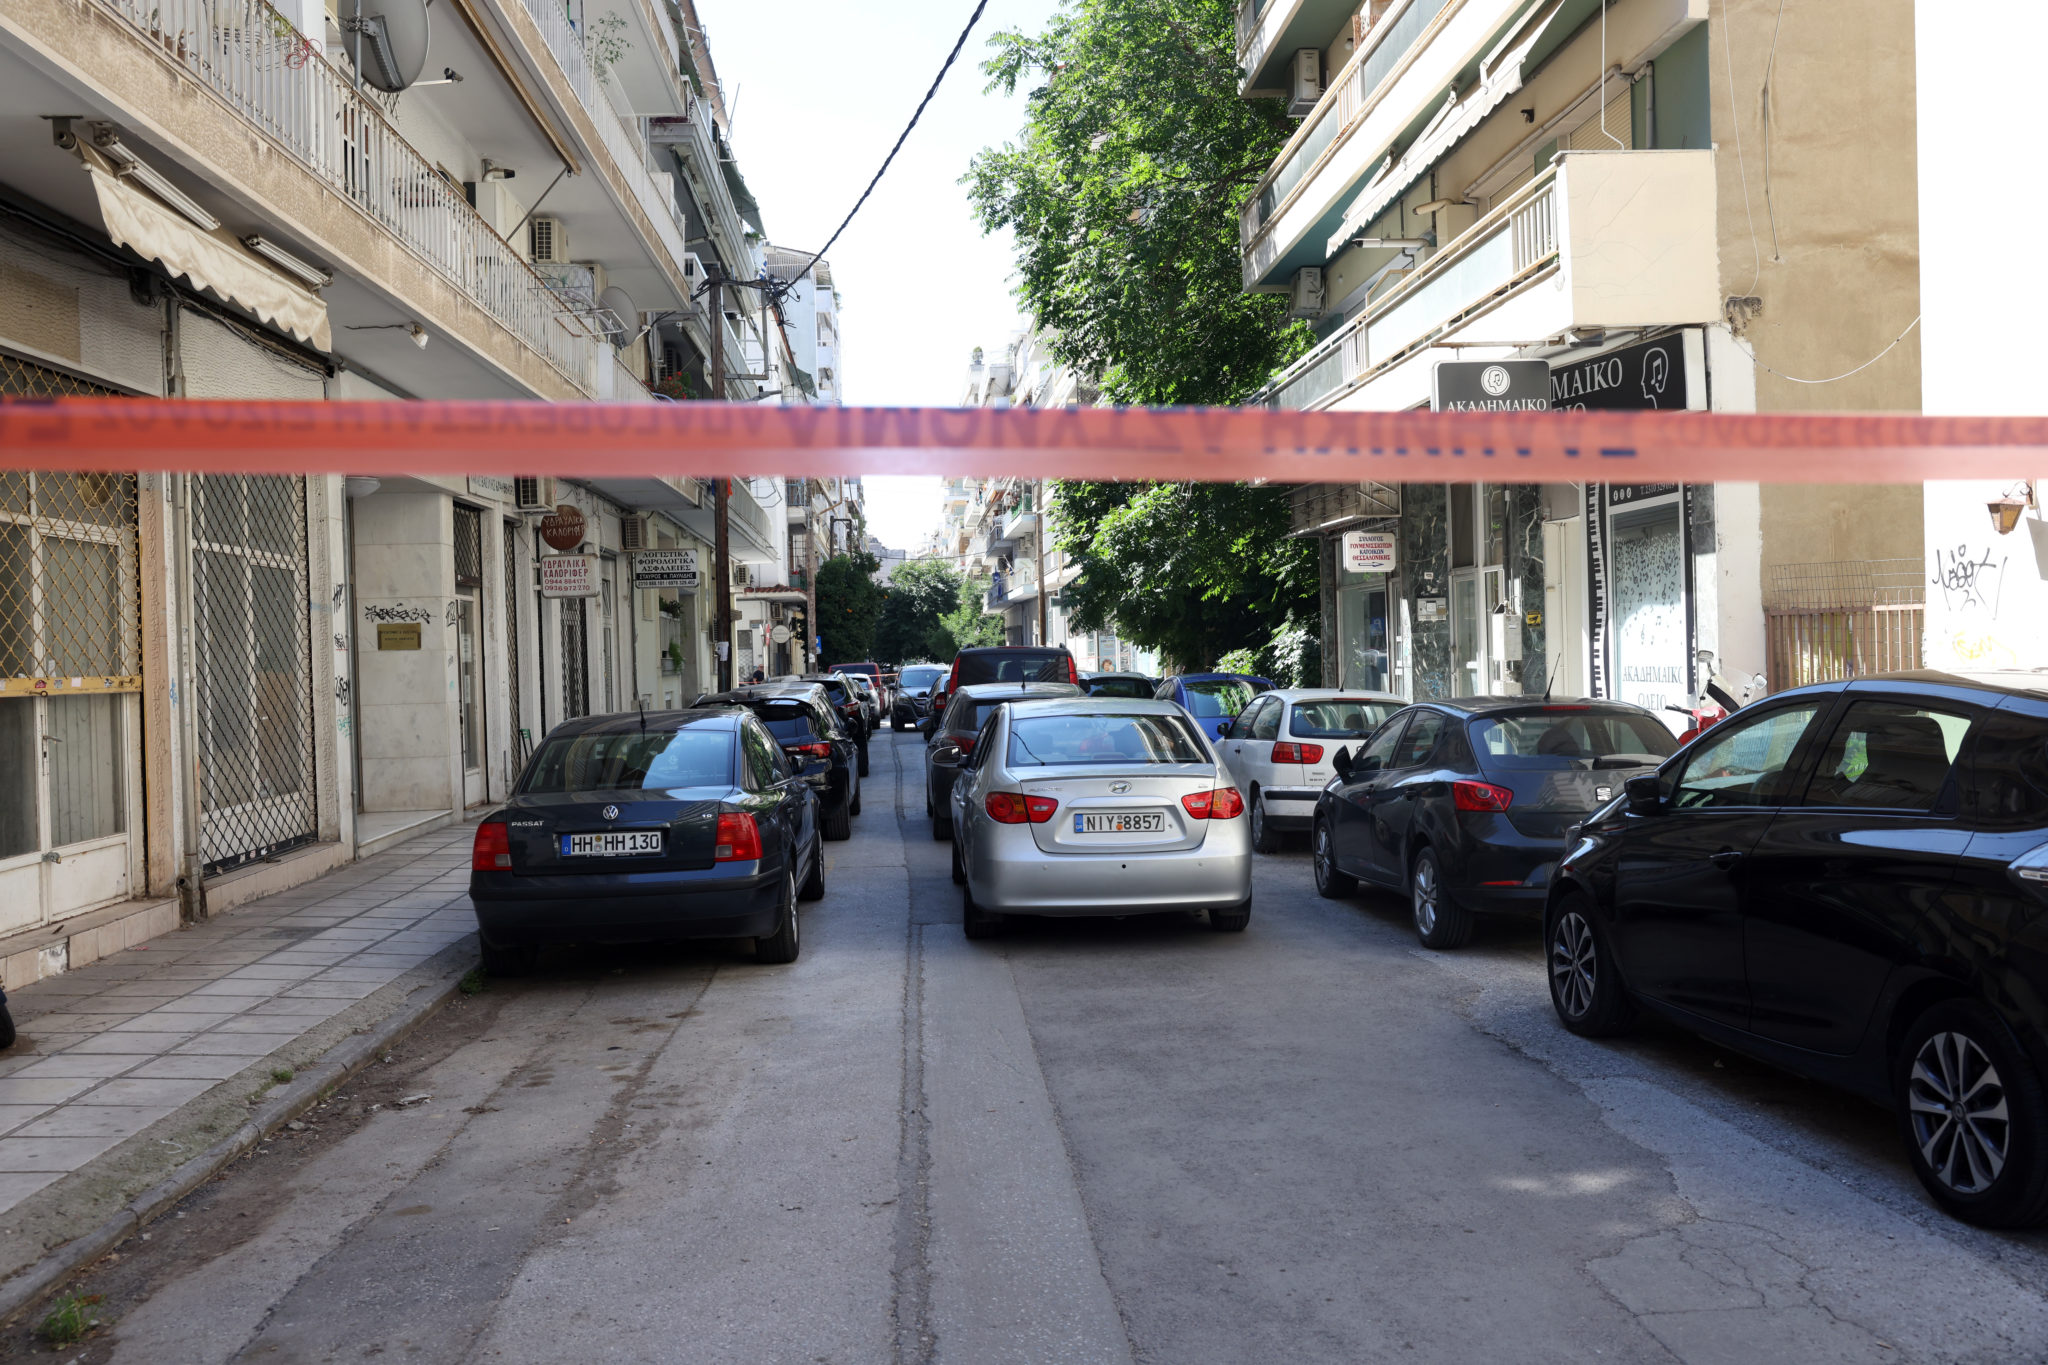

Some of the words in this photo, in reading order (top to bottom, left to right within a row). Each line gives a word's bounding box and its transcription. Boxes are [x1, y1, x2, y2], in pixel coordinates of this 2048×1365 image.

[1447, 398, 1547, 413] ΑΚΑΔΗΜΑΪΚΟ
[543, 559, 586, 569] ΥΔΡΑΥΛΙΚΑ
[543, 568, 589, 578] ΚΑΛΟΡΙΦΕΡ
[629, 834, 660, 851] 130
